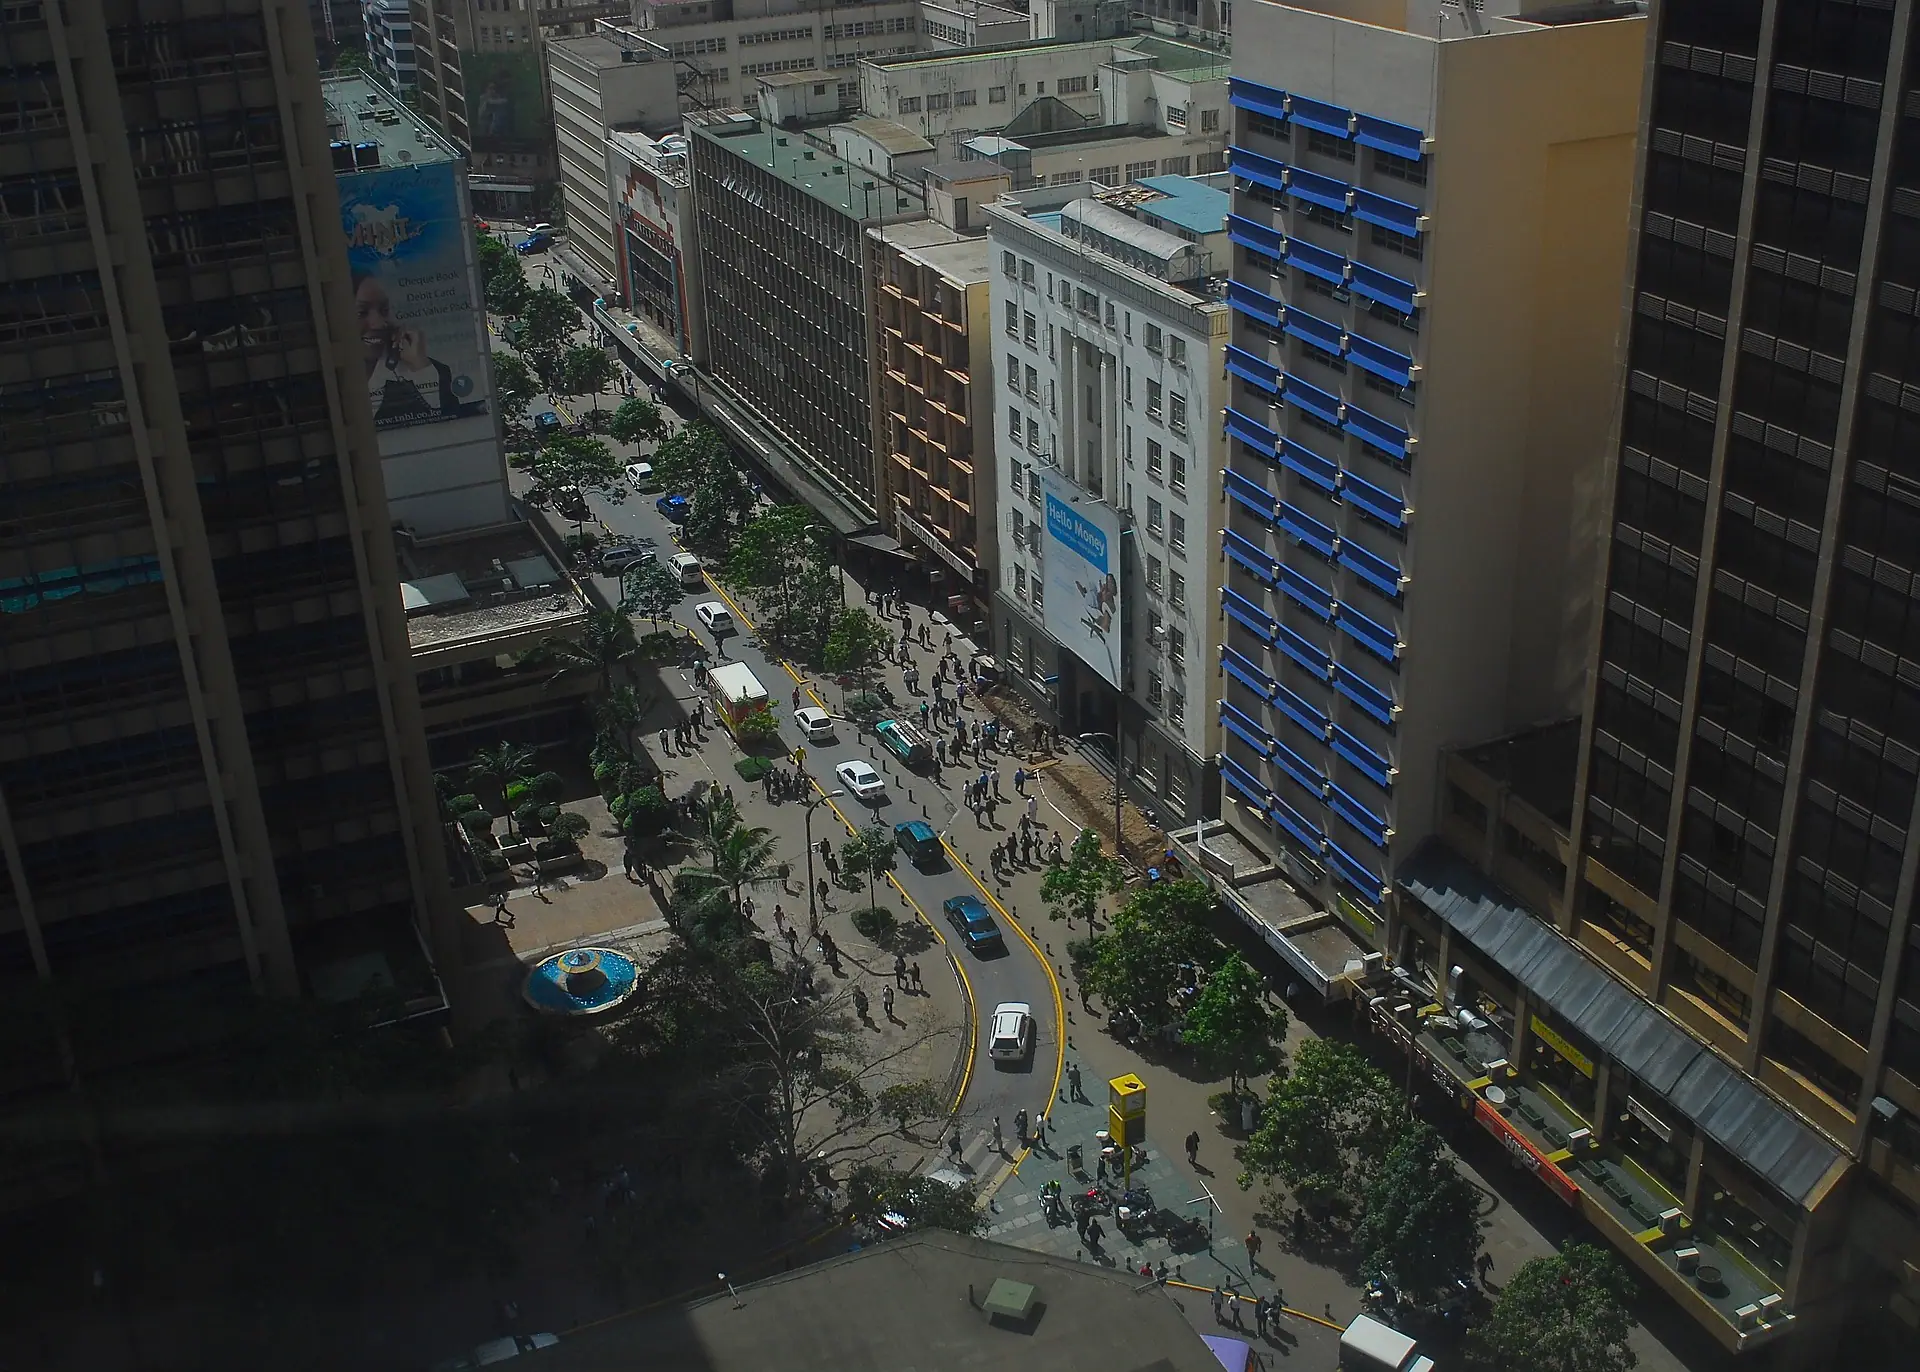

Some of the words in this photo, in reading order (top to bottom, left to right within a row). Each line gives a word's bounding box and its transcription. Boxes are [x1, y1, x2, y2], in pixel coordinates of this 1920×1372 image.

[398, 276, 434, 287] Cheque
[436, 270, 460, 281] Book
[406, 291, 432, 301] Debit
[434, 287, 456, 298] Card
[395, 308, 421, 320] Good
[422, 304, 448, 317] Value
[449, 301, 471, 312] Pack
[1049, 502, 1072, 530] Hello
[1074, 519, 1105, 557] Money
